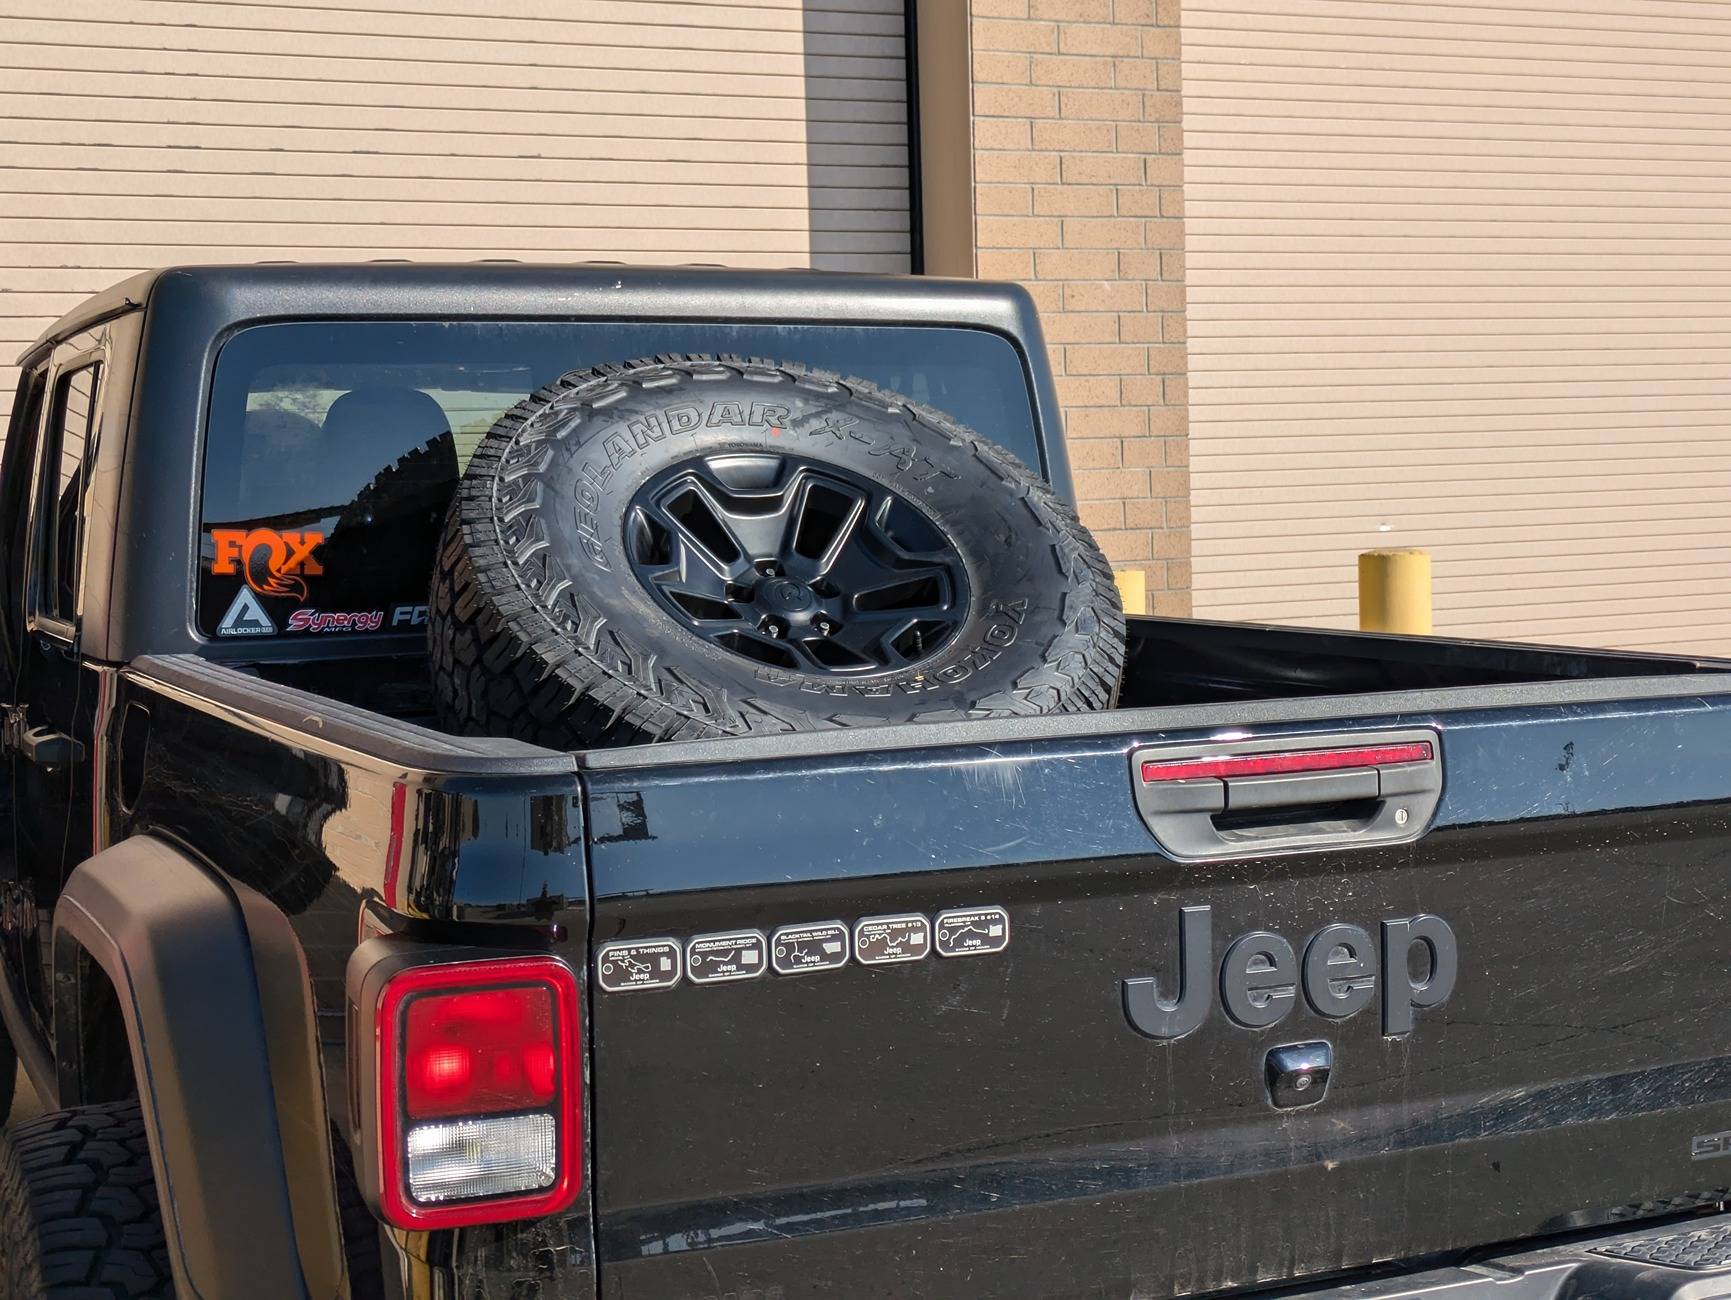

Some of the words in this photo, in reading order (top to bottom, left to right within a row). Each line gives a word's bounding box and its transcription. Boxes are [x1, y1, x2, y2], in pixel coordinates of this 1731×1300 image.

[574, 400, 793, 572] GEOLANDAR
[212, 528, 325, 598] FOX
[286, 608, 384, 632] Synergy
[609, 949, 628, 957] FINS
[639, 946, 670, 955] THINGS
[695, 940, 736, 949] MONUMENT
[801, 955, 820, 963] Jeep
[717, 964, 737, 972] Jeep
[1121, 904, 1458, 1040] Jeep
